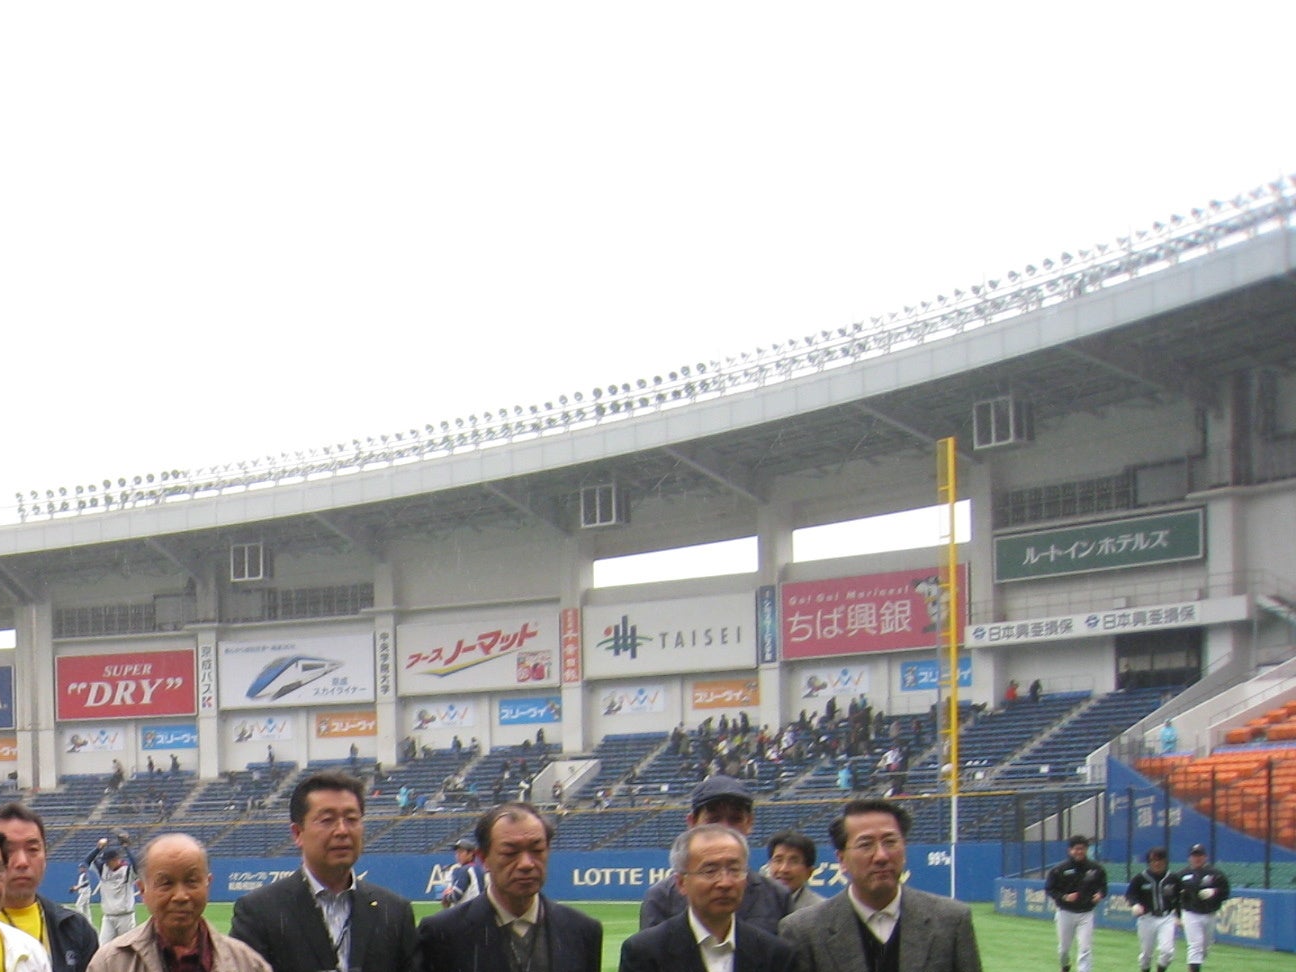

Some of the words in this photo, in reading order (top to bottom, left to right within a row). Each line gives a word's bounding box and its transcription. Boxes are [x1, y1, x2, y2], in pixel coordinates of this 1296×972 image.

[786, 599, 912, 643] ちば興銀
[988, 618, 1074, 642] 日本興亜損保
[1103, 604, 1197, 630] 日本興亜損保
[658, 625, 742, 650] TAISEI
[102, 663, 153, 677] SUPER
[573, 867, 644, 886] LOTTE
